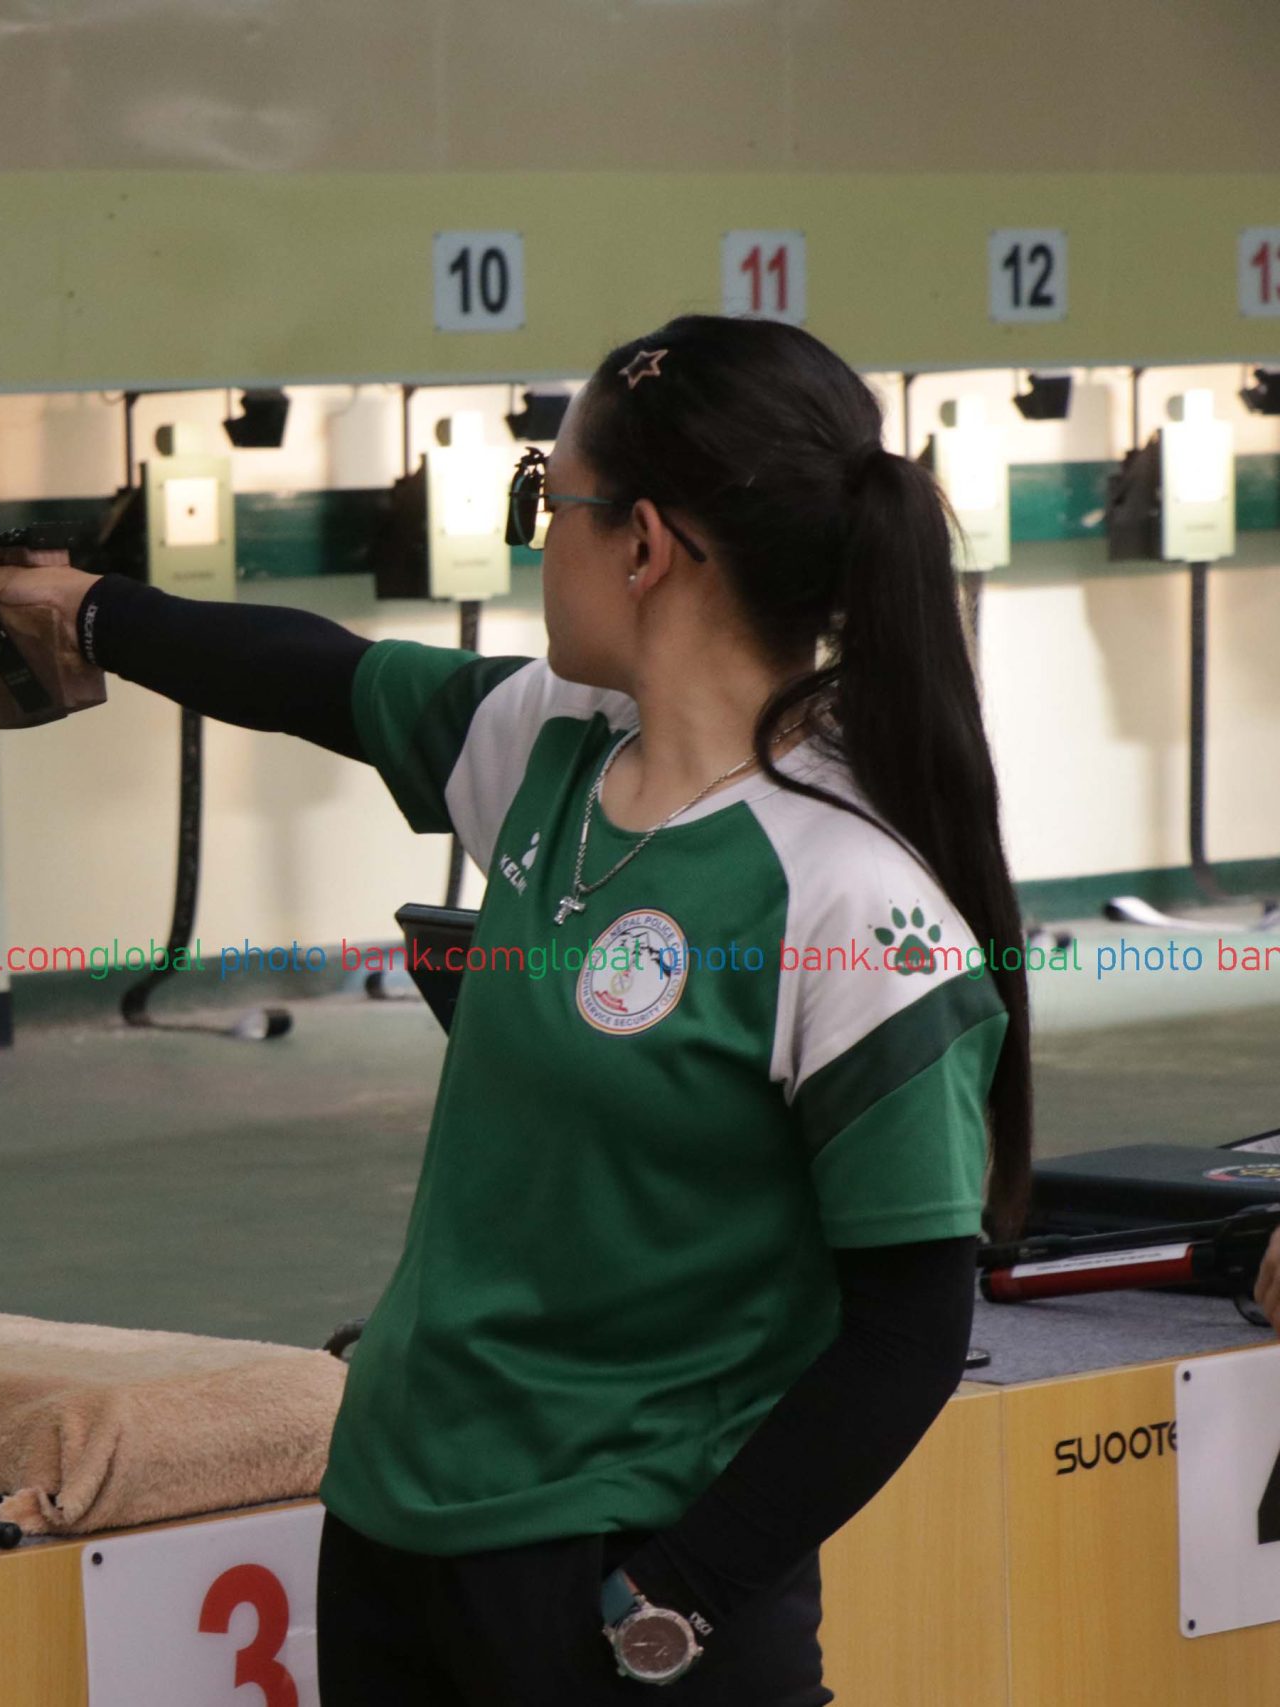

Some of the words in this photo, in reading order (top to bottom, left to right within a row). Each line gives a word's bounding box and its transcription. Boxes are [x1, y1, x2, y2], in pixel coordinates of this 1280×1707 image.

[447, 246, 511, 316] 10
[740, 245, 789, 312] 11
[1001, 242, 1056, 309] 12
[1250, 241, 1280, 304] 1
[610, 916, 641, 938] NEPAL
[643, 915, 676, 941] POLICE
[613, 1006, 661, 1028] SECURITY
[198, 1563, 299, 1707] 3
